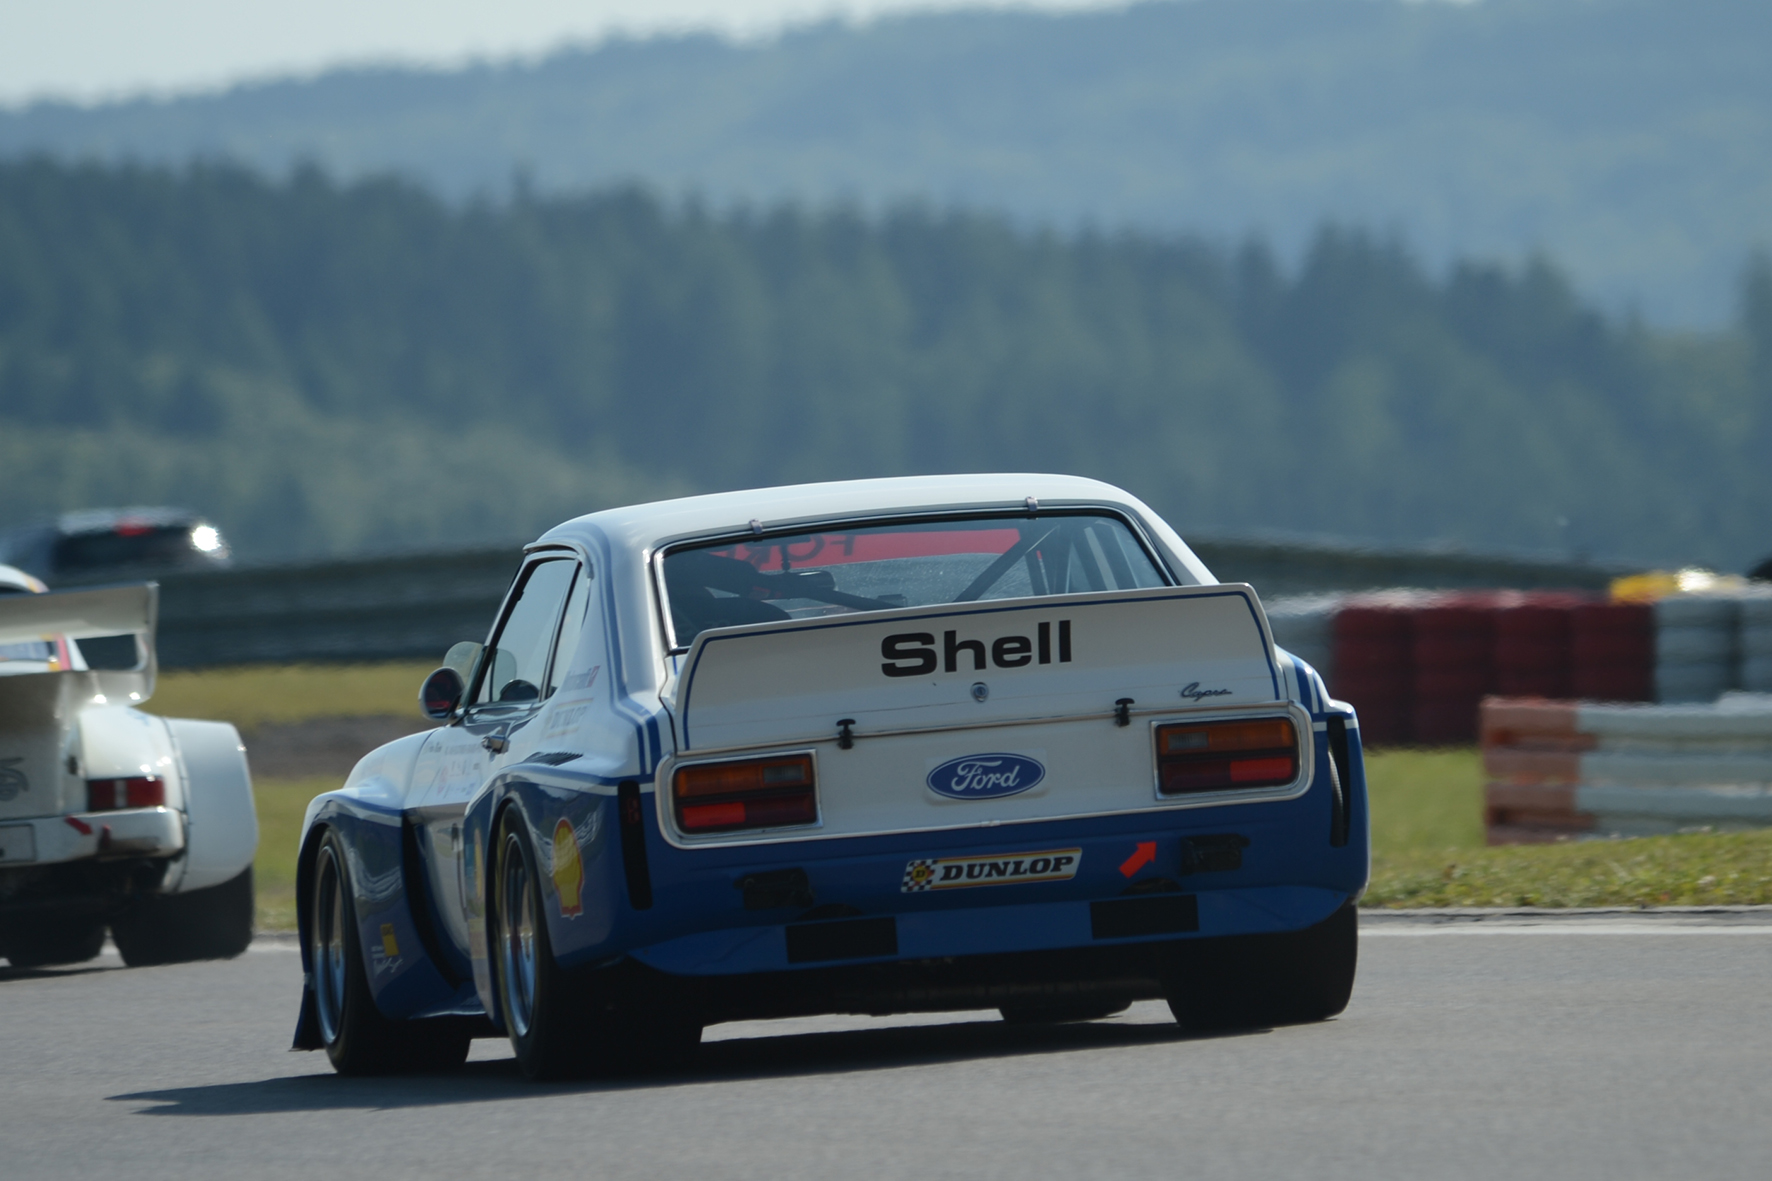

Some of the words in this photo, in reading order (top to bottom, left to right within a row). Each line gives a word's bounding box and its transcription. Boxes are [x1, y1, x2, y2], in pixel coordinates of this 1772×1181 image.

[881, 620, 1072, 678] Shell
[951, 760, 1020, 791] Ford
[939, 855, 1074, 882] DUNLOP
